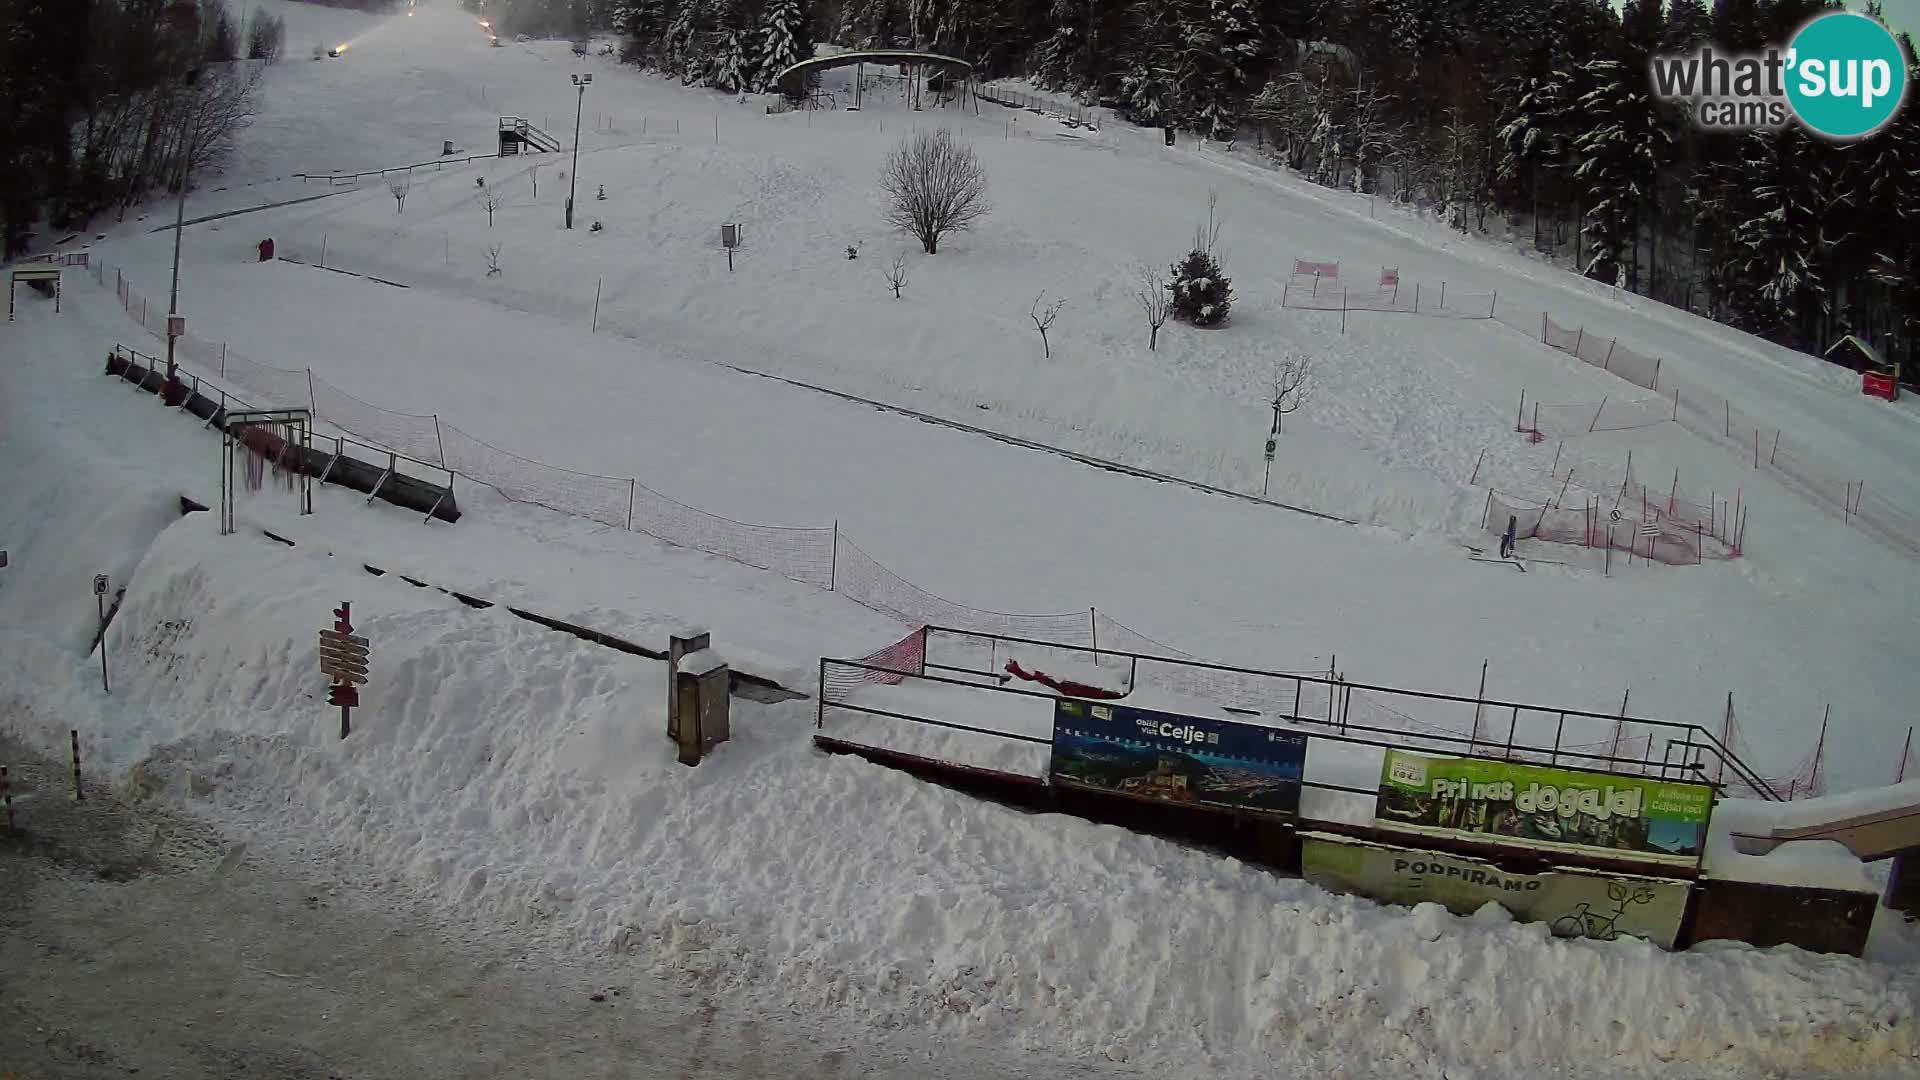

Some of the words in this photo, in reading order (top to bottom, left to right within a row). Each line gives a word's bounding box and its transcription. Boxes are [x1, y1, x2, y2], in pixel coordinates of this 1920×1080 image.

[1160, 722, 1205, 745] Celje
[1431, 777, 1467, 800] Pri
[1472, 779, 1514, 802] nas
[1394, 858, 1542, 892] PODPIRAMO
